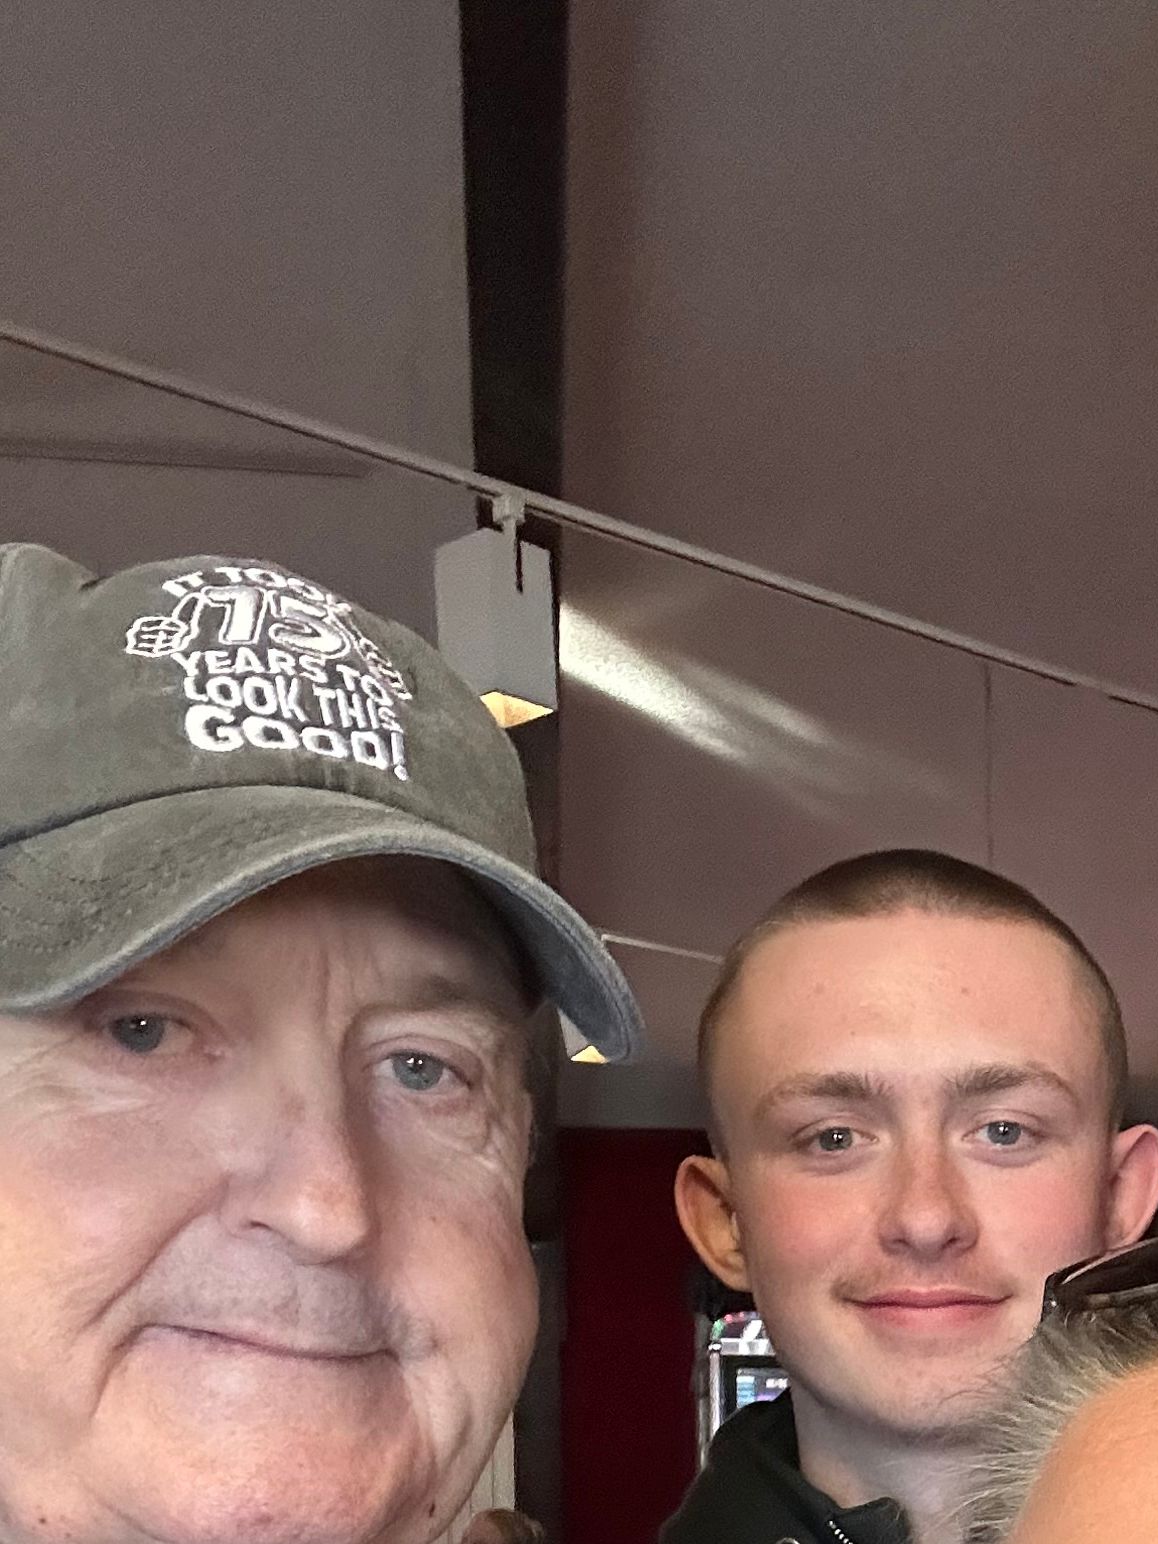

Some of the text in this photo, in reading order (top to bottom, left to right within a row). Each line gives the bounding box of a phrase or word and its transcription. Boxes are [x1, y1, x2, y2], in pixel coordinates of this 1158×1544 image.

[161, 570, 204, 598] IT
[201, 585, 350, 661] 75
[170, 646, 394, 707] YEARS TO
[183, 675, 403, 734] LOOK THIS
[184, 703, 408, 782] GOOD!
